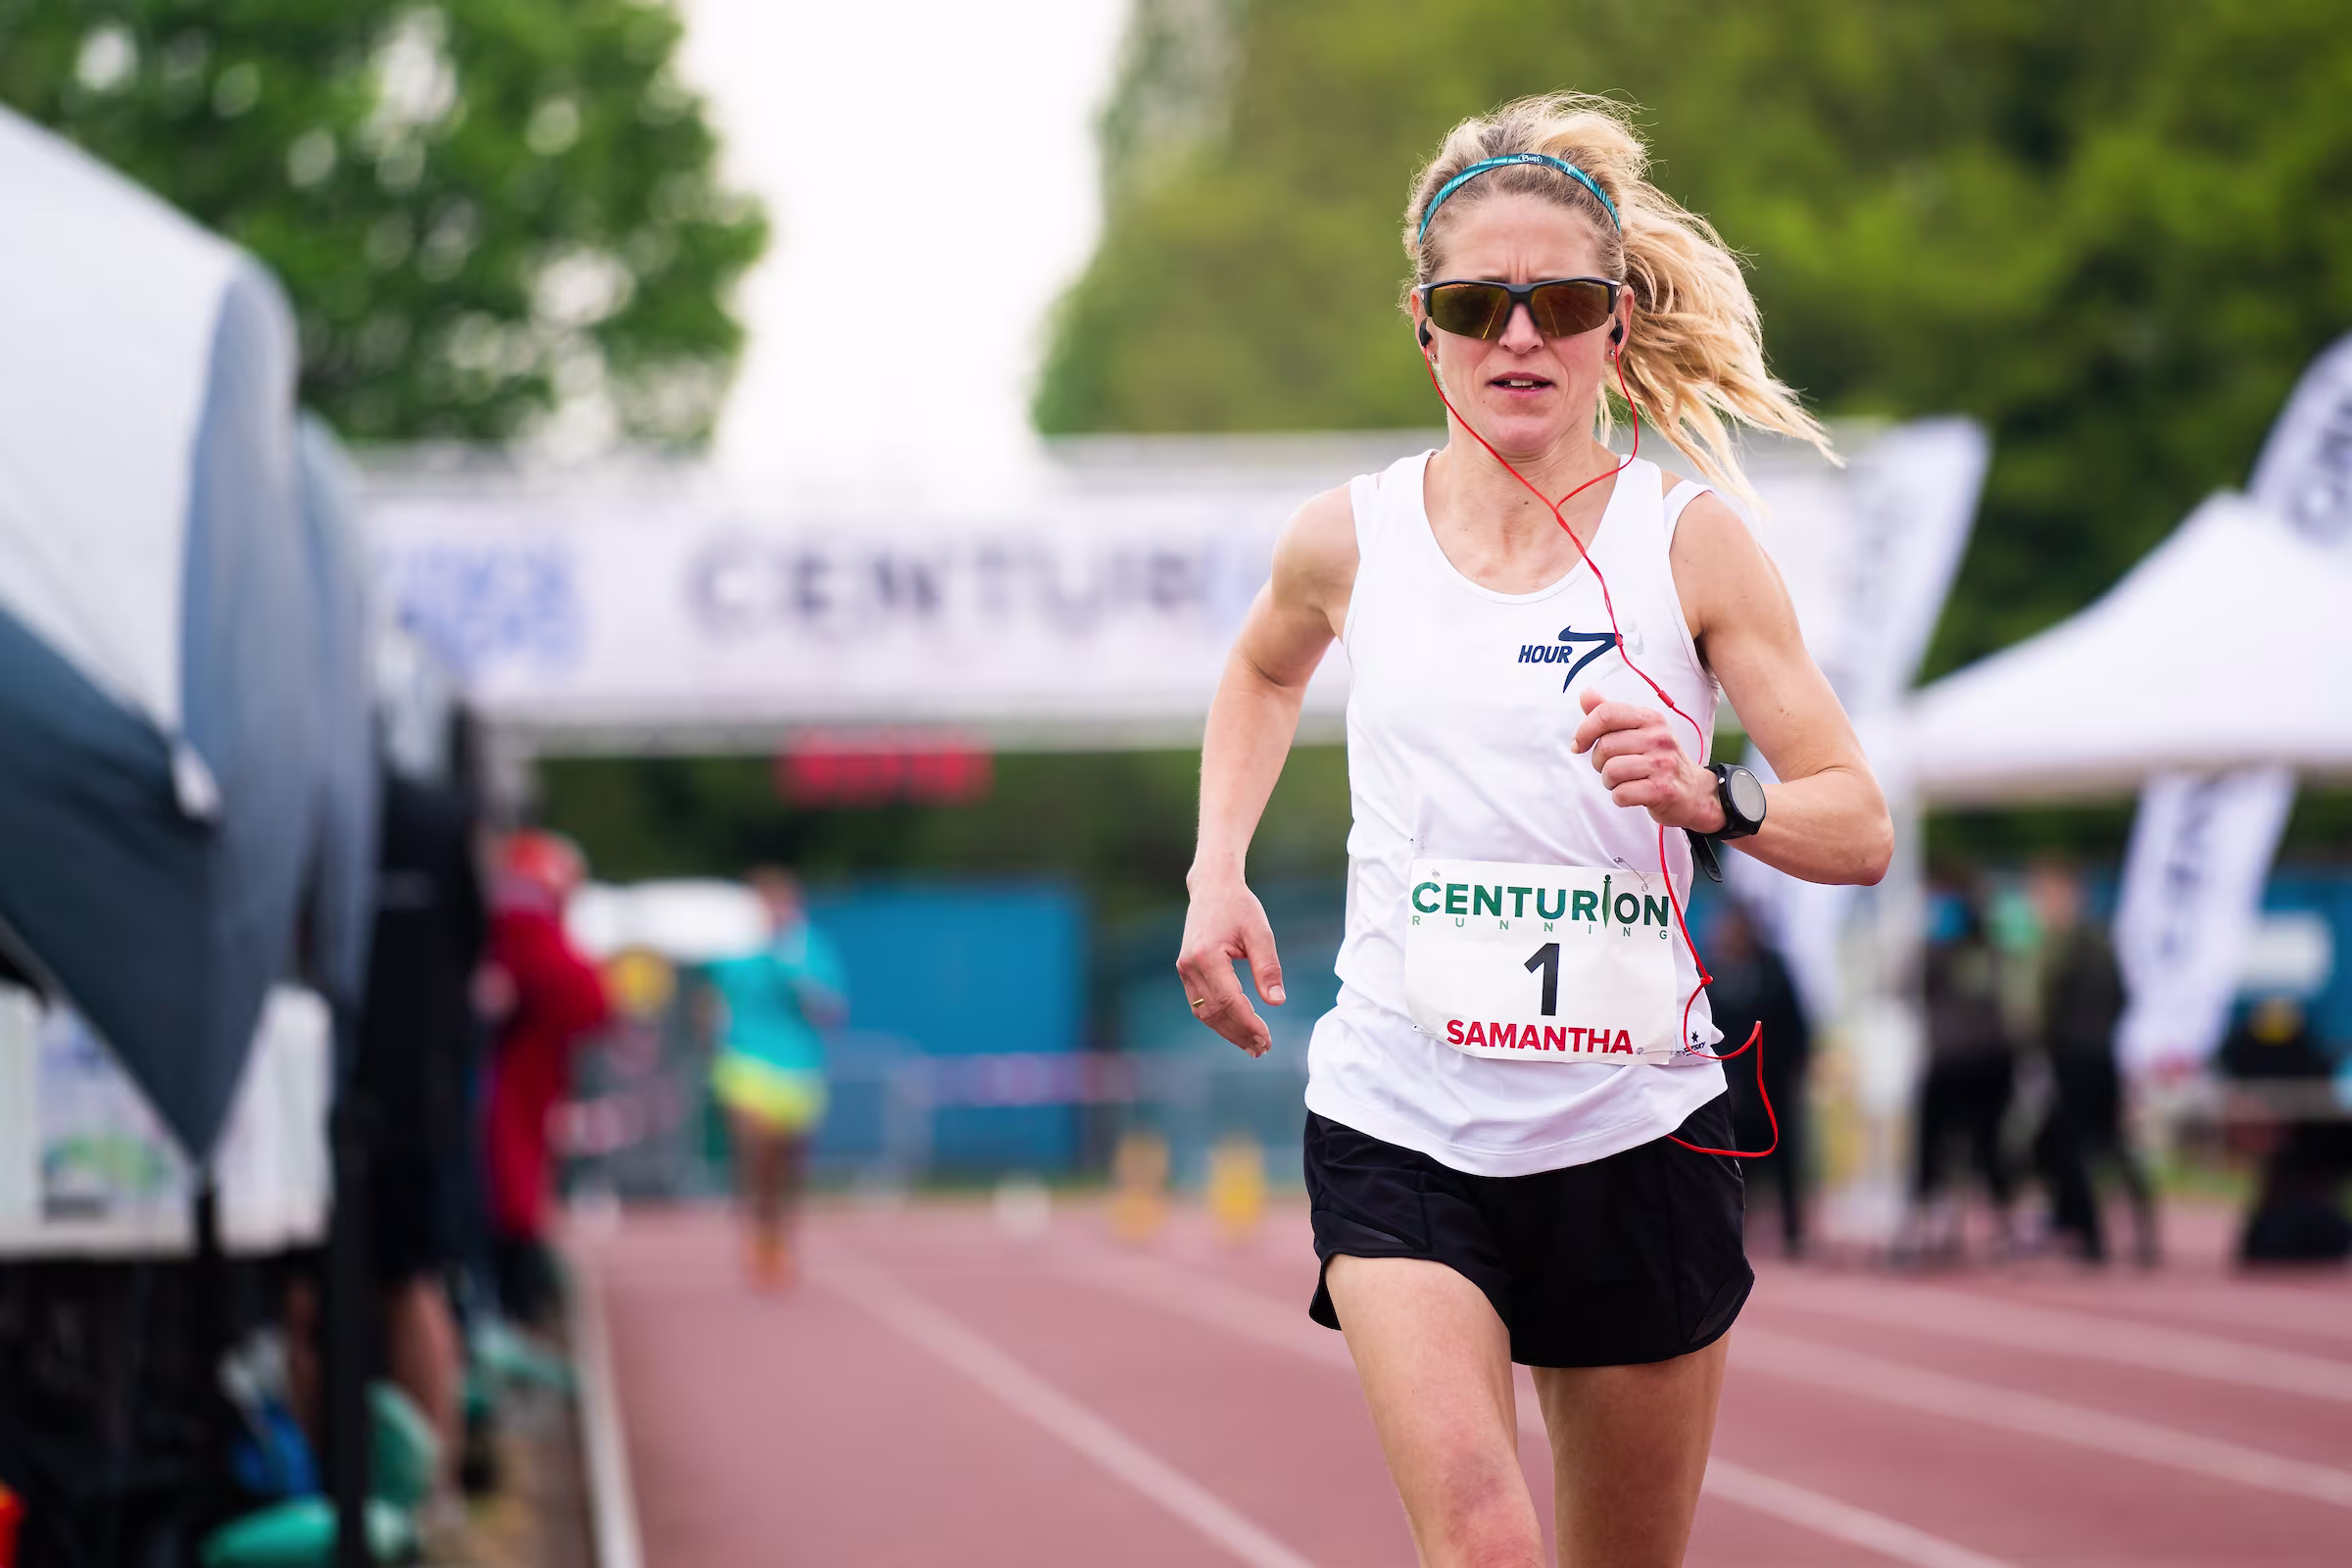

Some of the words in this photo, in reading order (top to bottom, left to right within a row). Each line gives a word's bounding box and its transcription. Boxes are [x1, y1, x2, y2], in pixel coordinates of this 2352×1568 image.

[1518, 645, 1573, 663] HOUR
[1412, 874, 1669, 929] CENTURION
[1412, 915, 1668, 941] RUNNING
[1524, 942, 1560, 1017] 1
[1446, 1019, 1634, 1055] SAMANTHA
